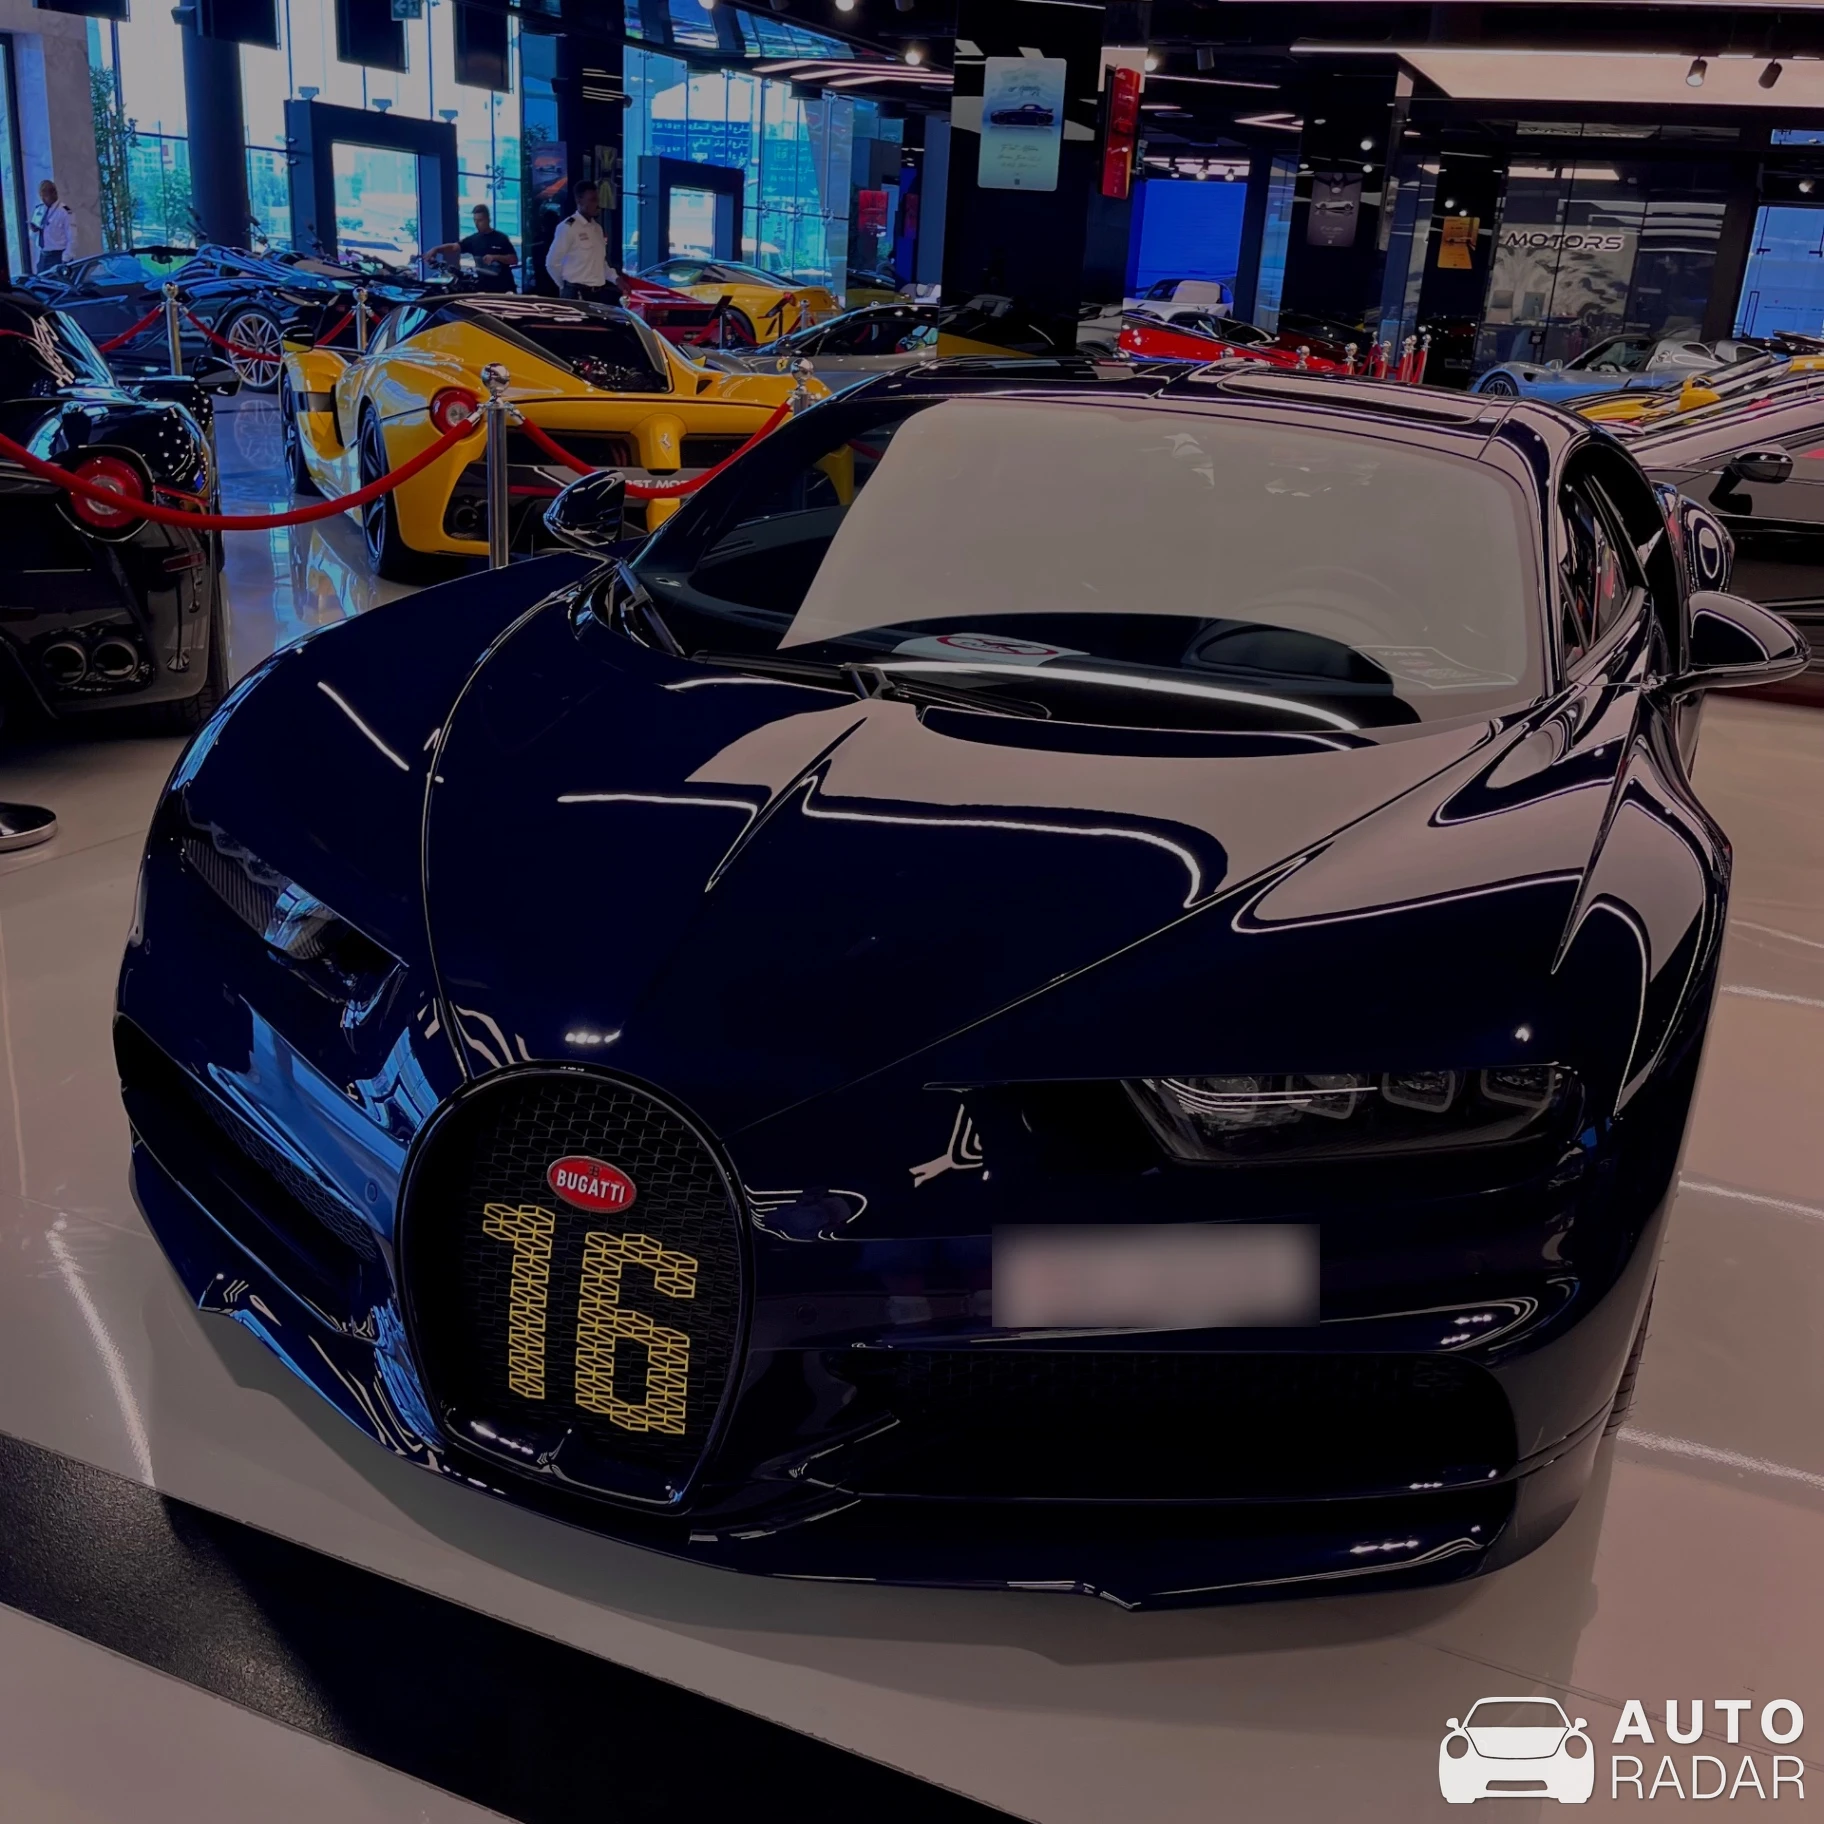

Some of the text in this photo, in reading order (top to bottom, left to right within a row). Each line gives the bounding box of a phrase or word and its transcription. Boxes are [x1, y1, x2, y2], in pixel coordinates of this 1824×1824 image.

[1504, 231, 1624, 251] MOTORS
[556, 1169, 626, 1203] BUGATTI
[483, 1202, 698, 1434] 16
